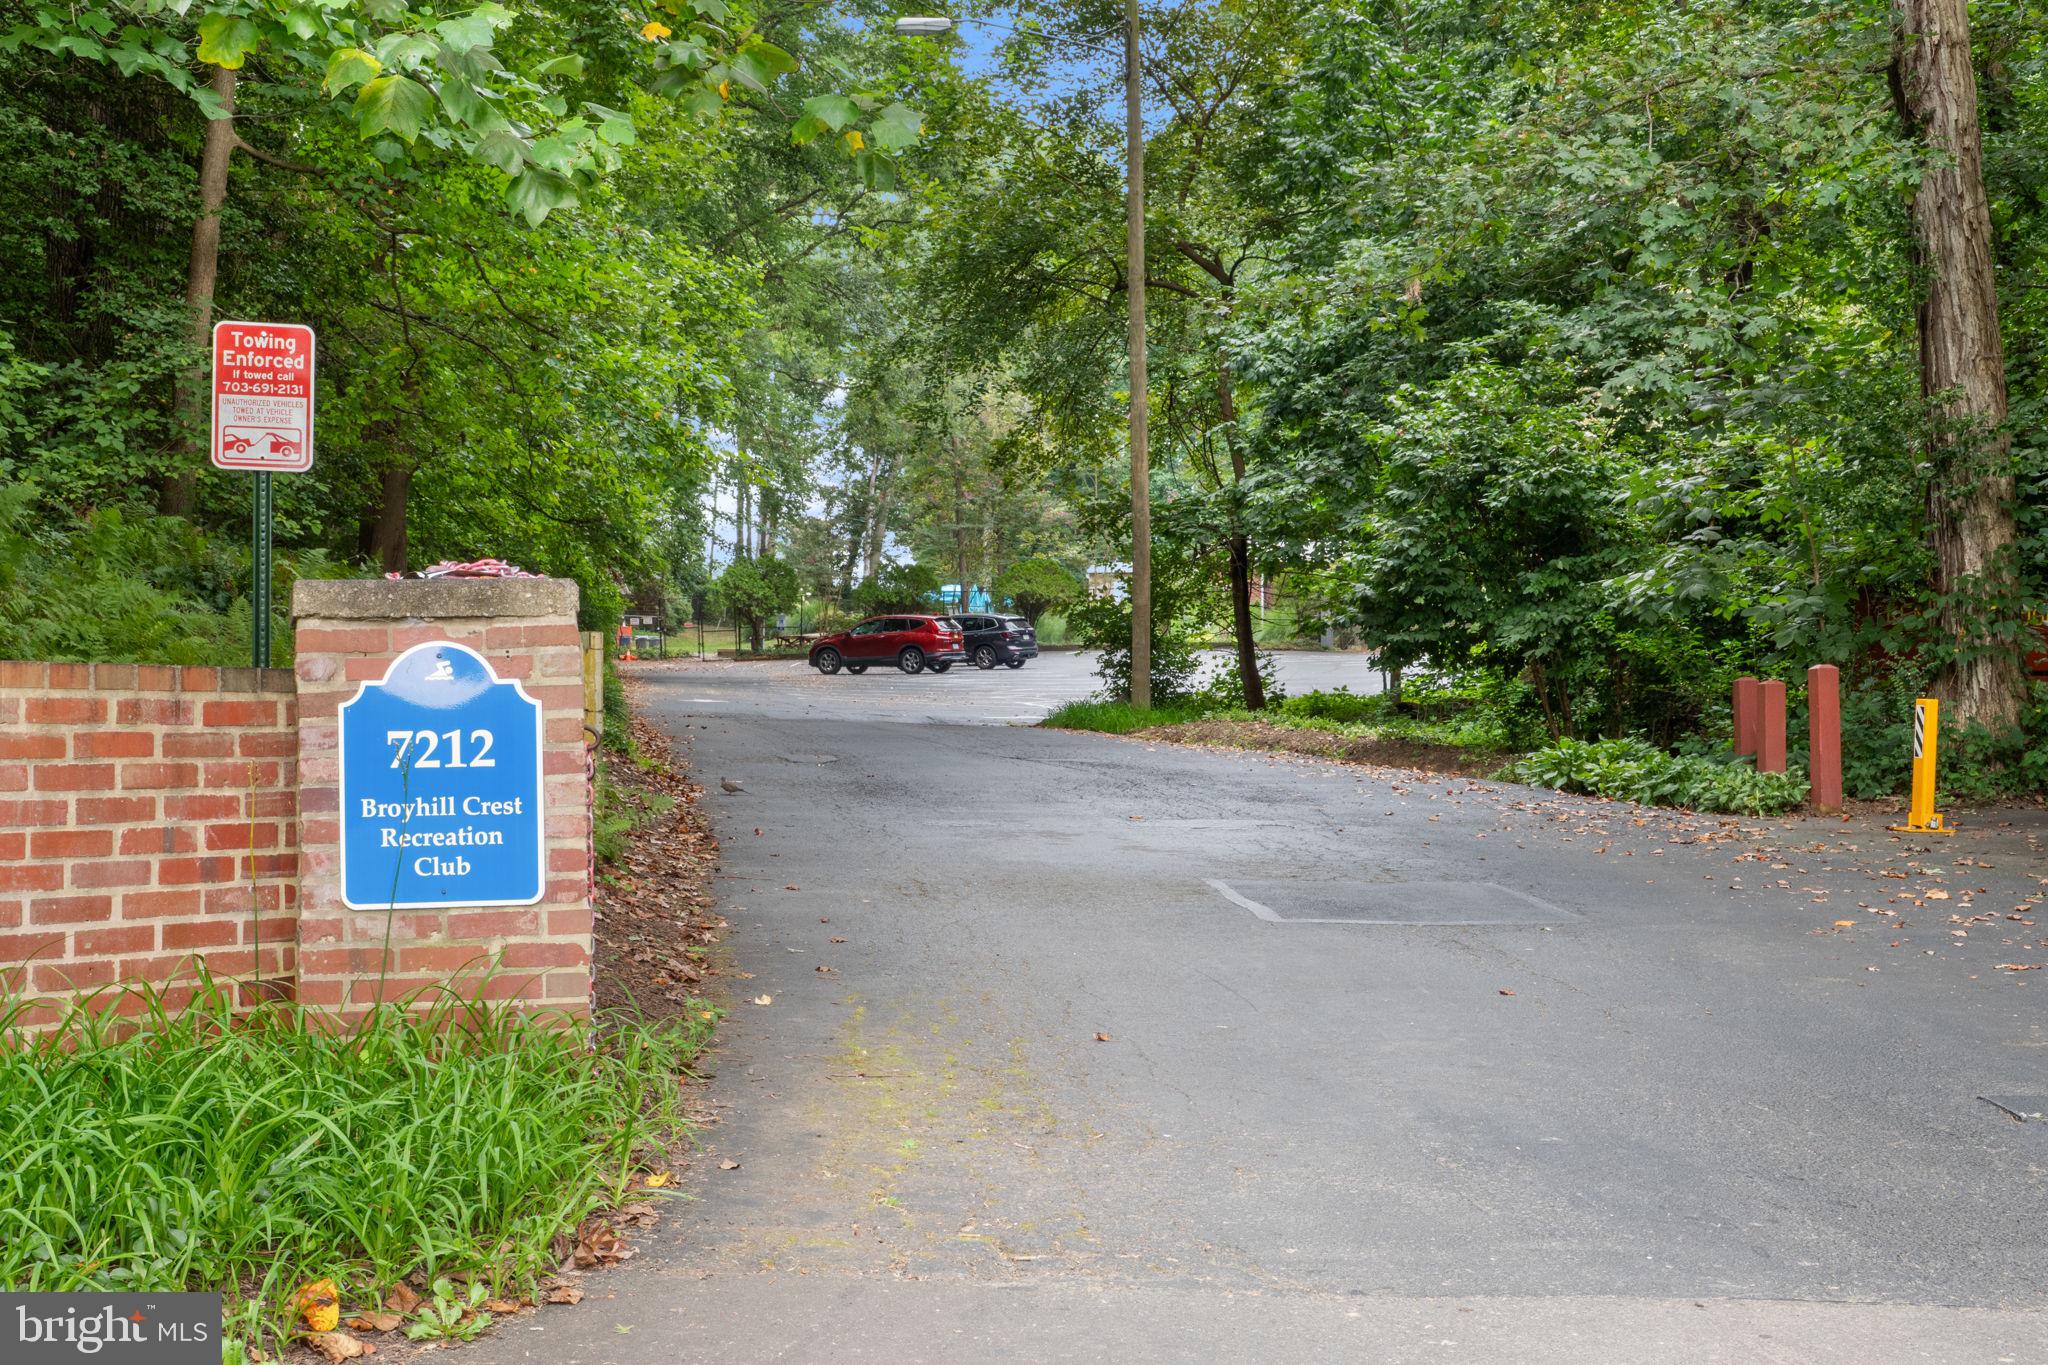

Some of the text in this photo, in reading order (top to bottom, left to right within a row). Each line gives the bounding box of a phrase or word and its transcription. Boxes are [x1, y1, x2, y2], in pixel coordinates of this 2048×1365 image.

[231, 331, 296, 354] Towing
[223, 350, 305, 369] Enforced
[233, 370, 294, 381] If towed call
[223, 382, 303, 395] 703-691-2131
[222, 398, 304, 408] UNAUTHORIZED VEHICLES
[387, 729, 496, 769] 7212
[361, 796, 523, 823] Broyhill Crest
[380, 826, 503, 848] Recreation
[414, 857, 471, 876] Club
